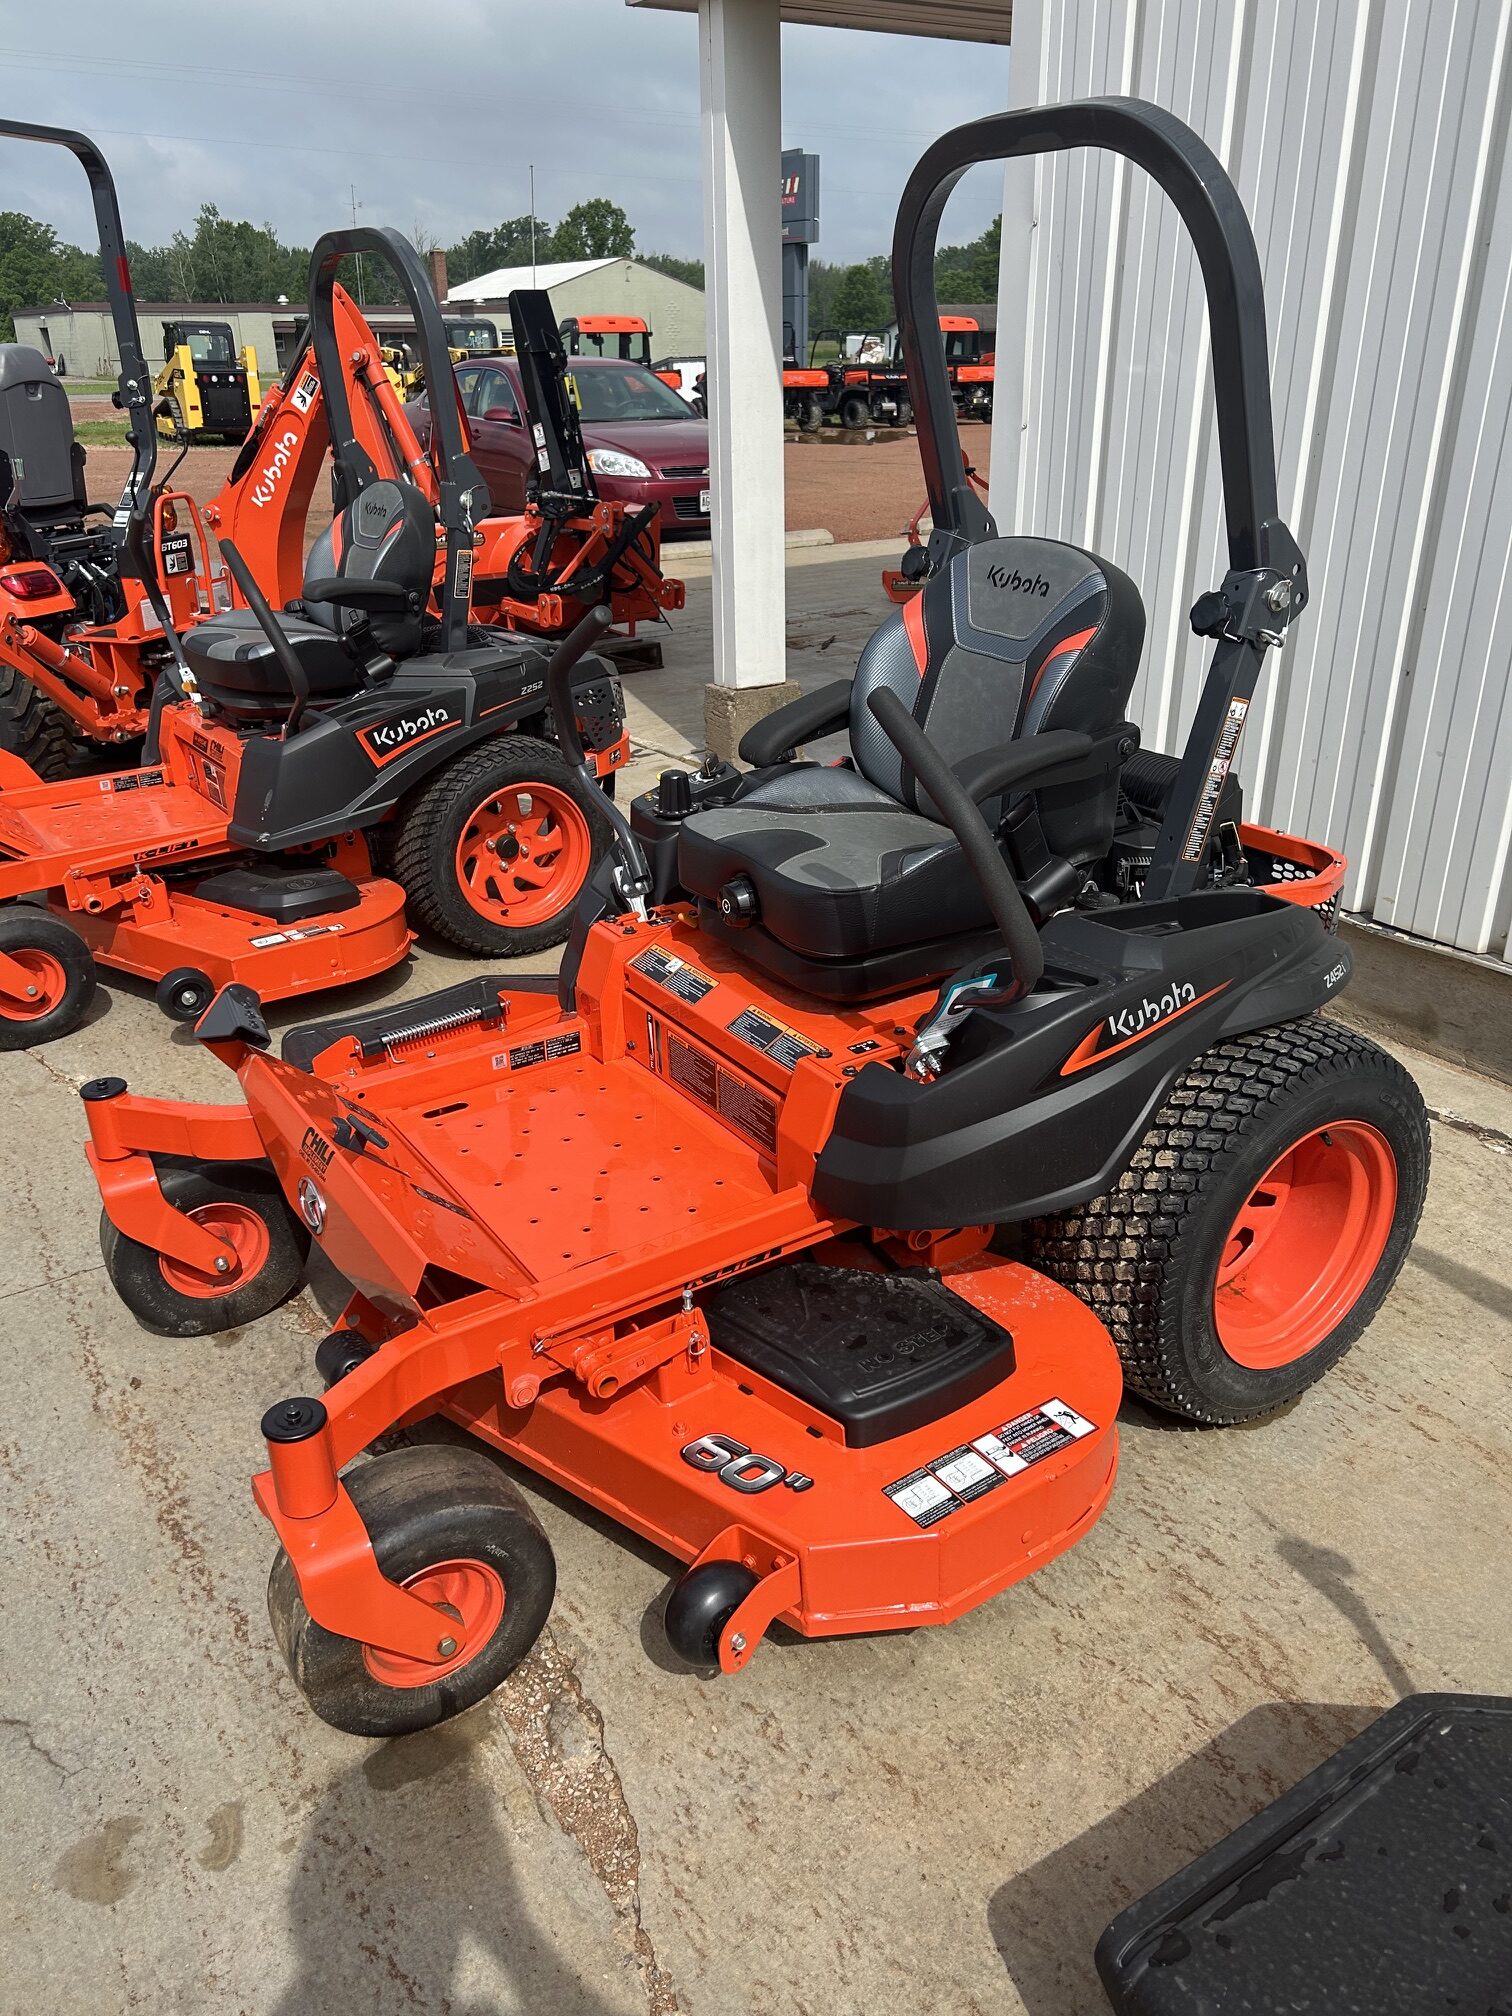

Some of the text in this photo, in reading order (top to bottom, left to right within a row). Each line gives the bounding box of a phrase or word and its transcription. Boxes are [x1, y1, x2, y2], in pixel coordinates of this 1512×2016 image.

[251, 432, 298, 508] Kubota
[365, 502, 387, 518] Kubota
[987, 564, 1050, 598] Kubota
[521, 681, 544, 695] Z252
[373, 708, 448, 748] Kubota
[136, 838, 197, 861] K-LIFT
[1323, 961, 1347, 989] Z452i
[1108, 982, 1196, 1037] Kubota
[302, 1127, 335, 1166] CHILI
